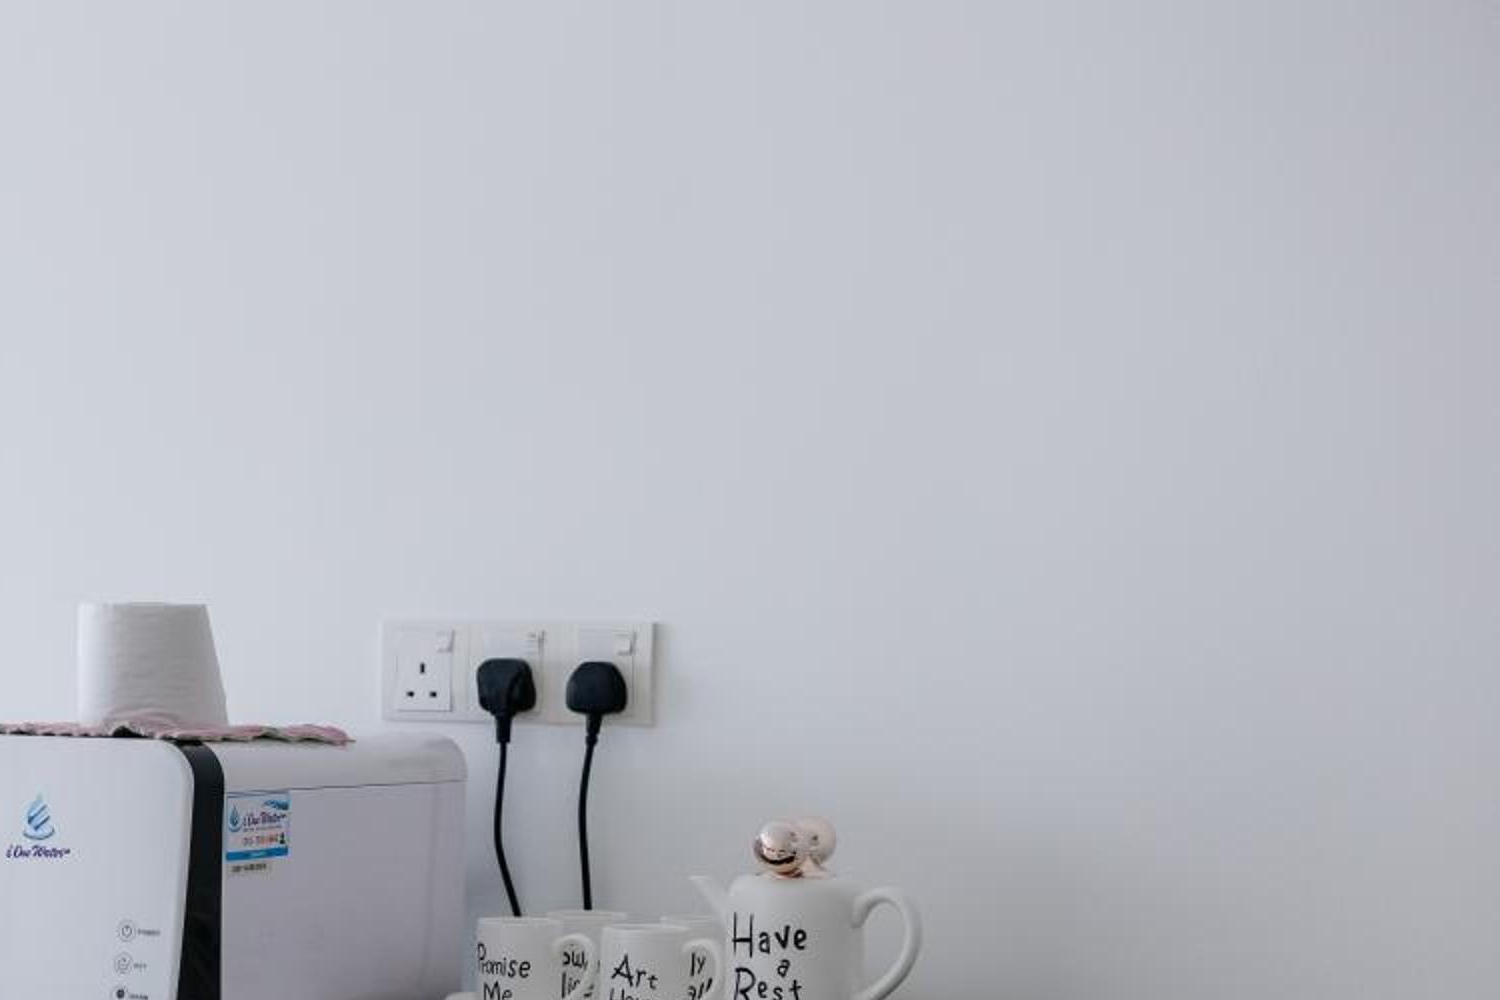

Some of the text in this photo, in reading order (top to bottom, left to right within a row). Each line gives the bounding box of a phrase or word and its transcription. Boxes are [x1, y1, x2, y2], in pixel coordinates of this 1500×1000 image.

[731, 911, 808, 958] Have
[477, 942, 532, 978] Promise
[611, 953, 659, 990] Art
[777, 958, 791, 978] a
